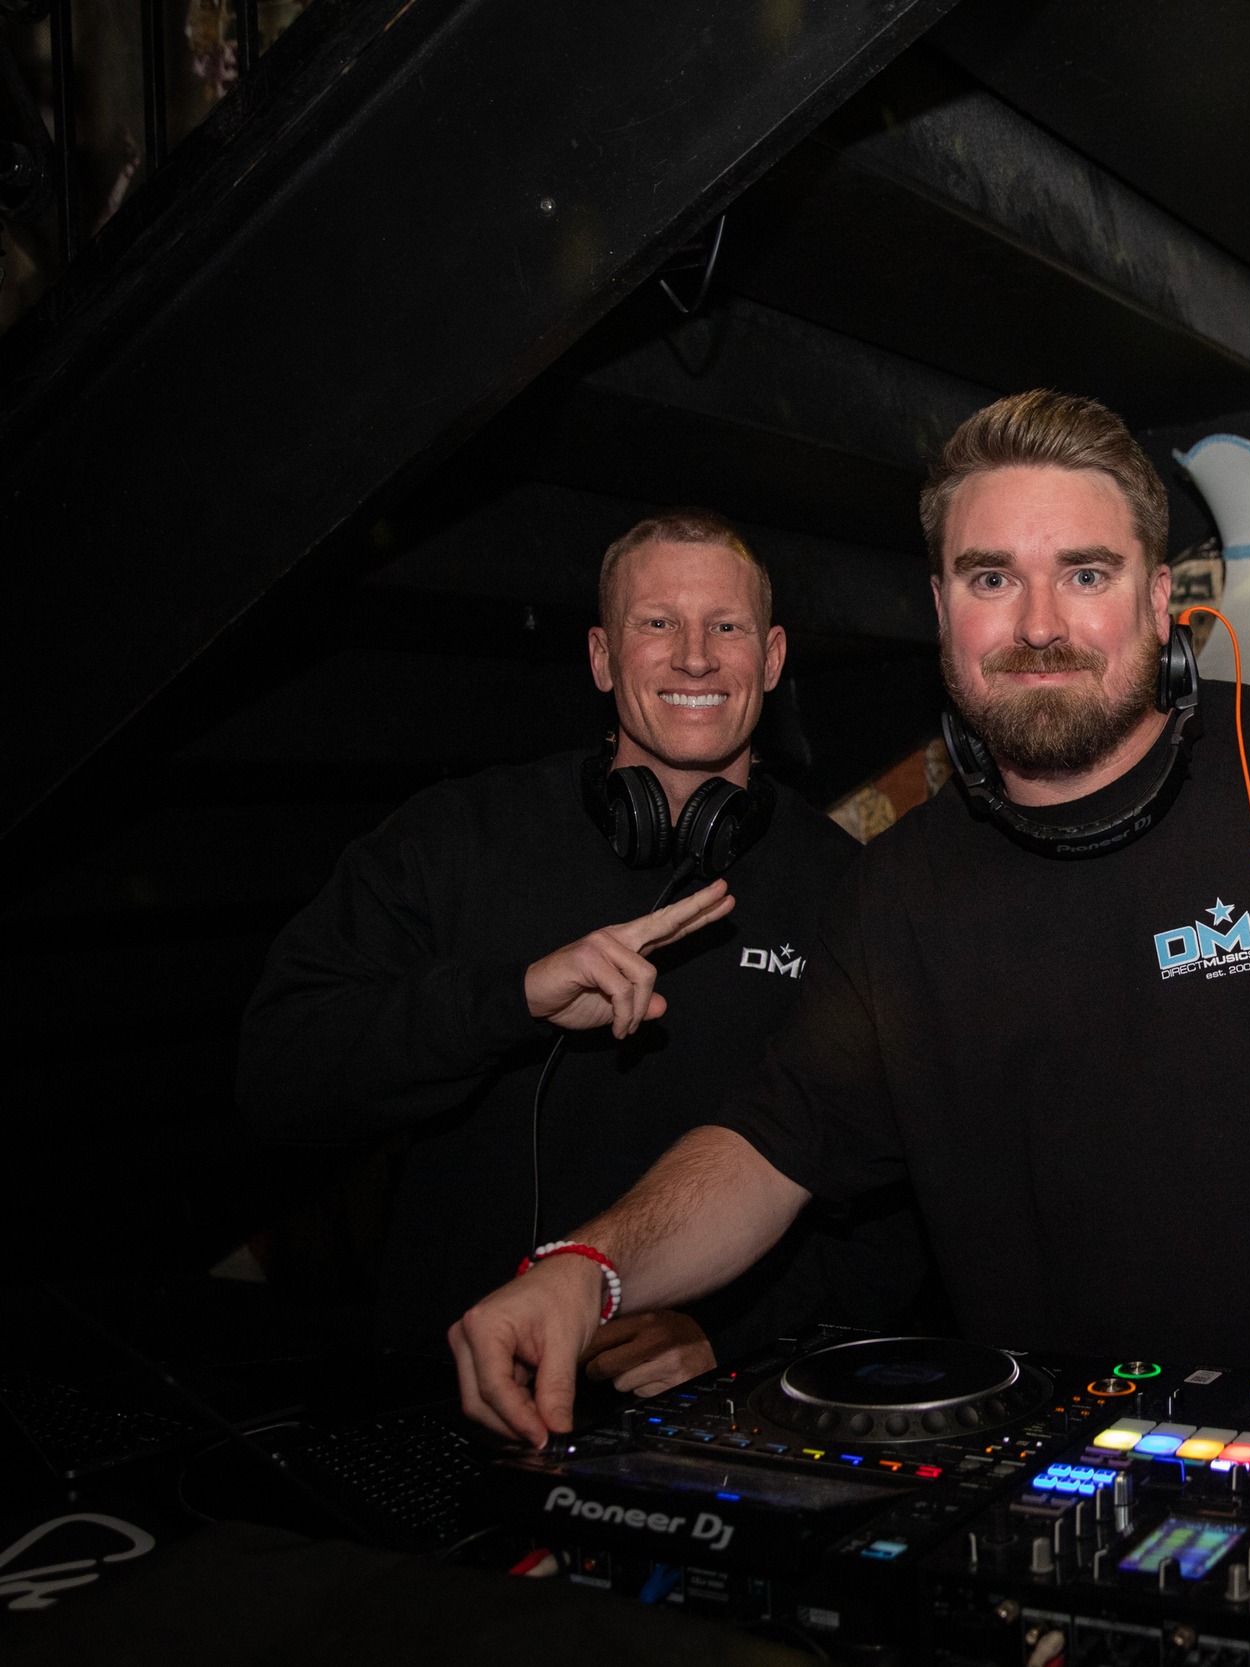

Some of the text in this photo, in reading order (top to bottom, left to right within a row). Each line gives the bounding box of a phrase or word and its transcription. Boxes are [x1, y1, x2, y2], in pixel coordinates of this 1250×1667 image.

[1056, 830, 1130, 853] Pioneer
[739, 946, 807, 980] DM
[1205, 969, 1227, 980] est.
[543, 1486, 686, 1535] Pioneer
